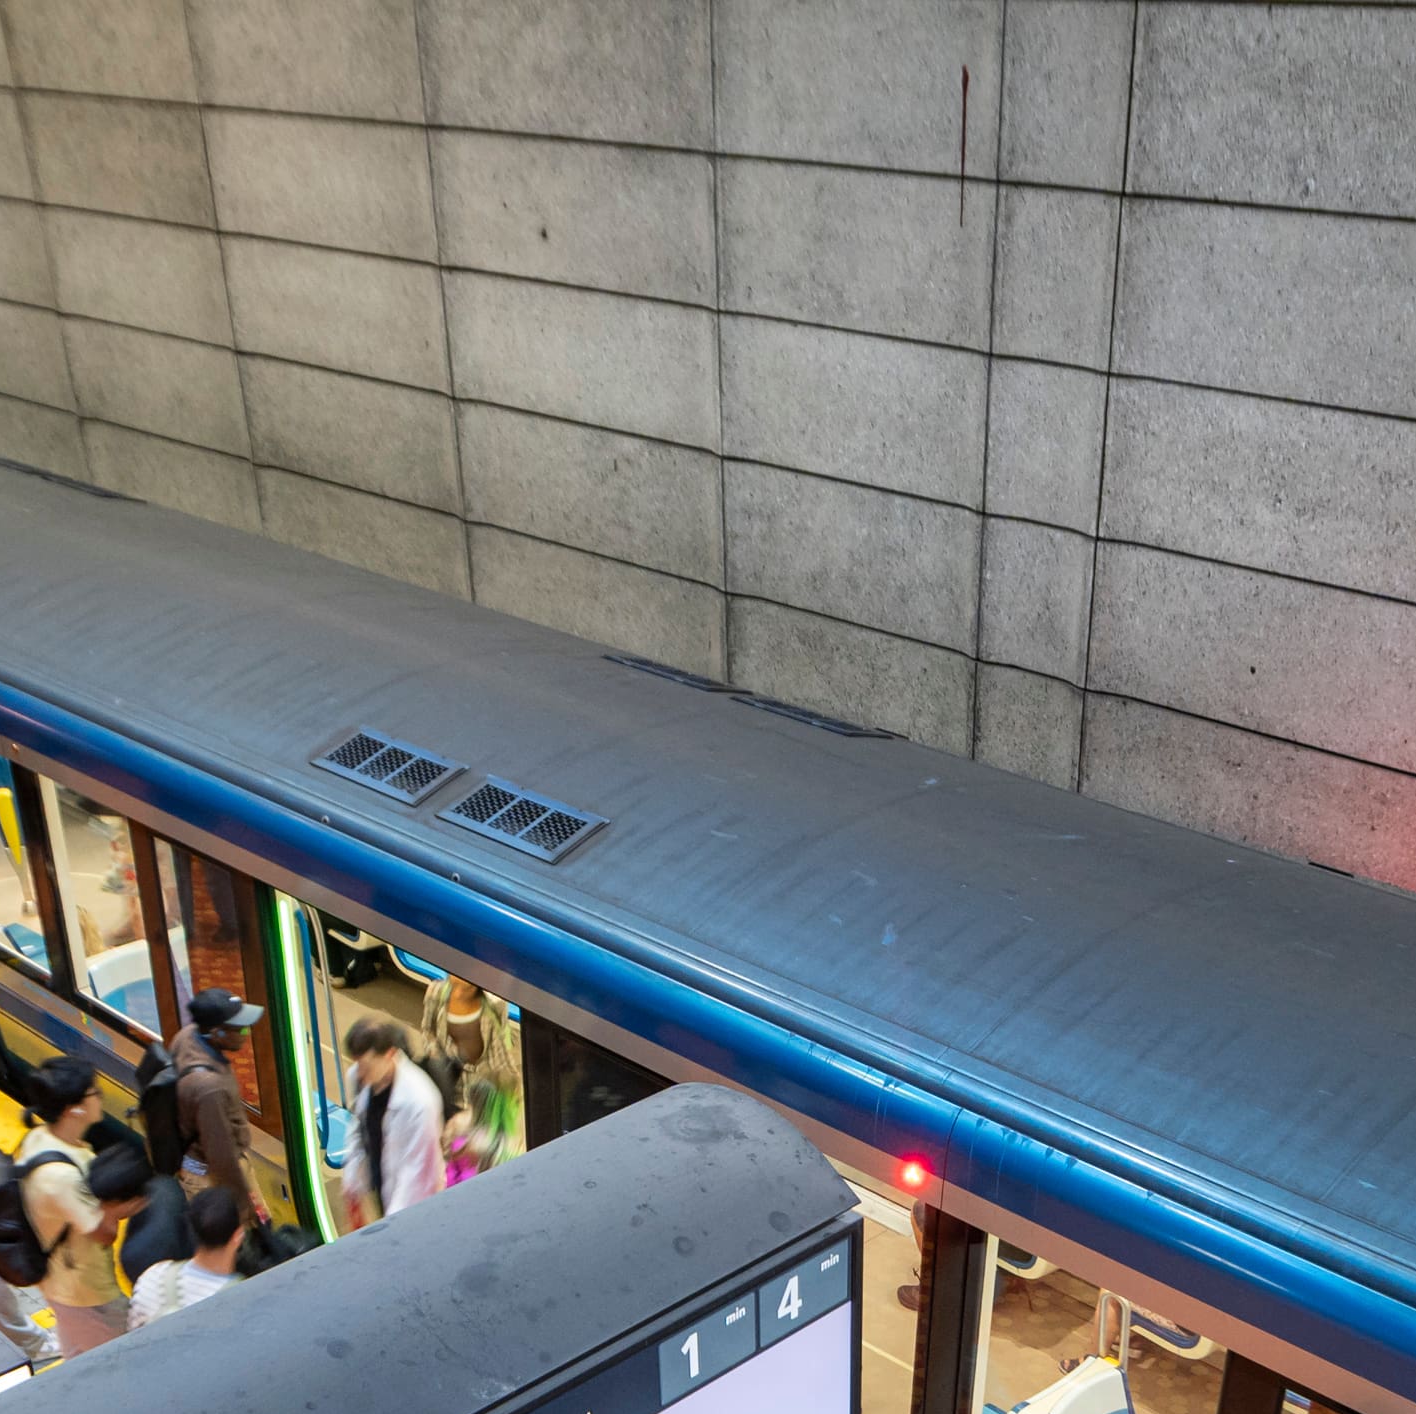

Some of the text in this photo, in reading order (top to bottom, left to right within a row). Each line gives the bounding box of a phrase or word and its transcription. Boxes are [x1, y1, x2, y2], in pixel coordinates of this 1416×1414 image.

[777, 1252, 840, 1320] 4 min
[681, 1305, 746, 1379] 1 min
